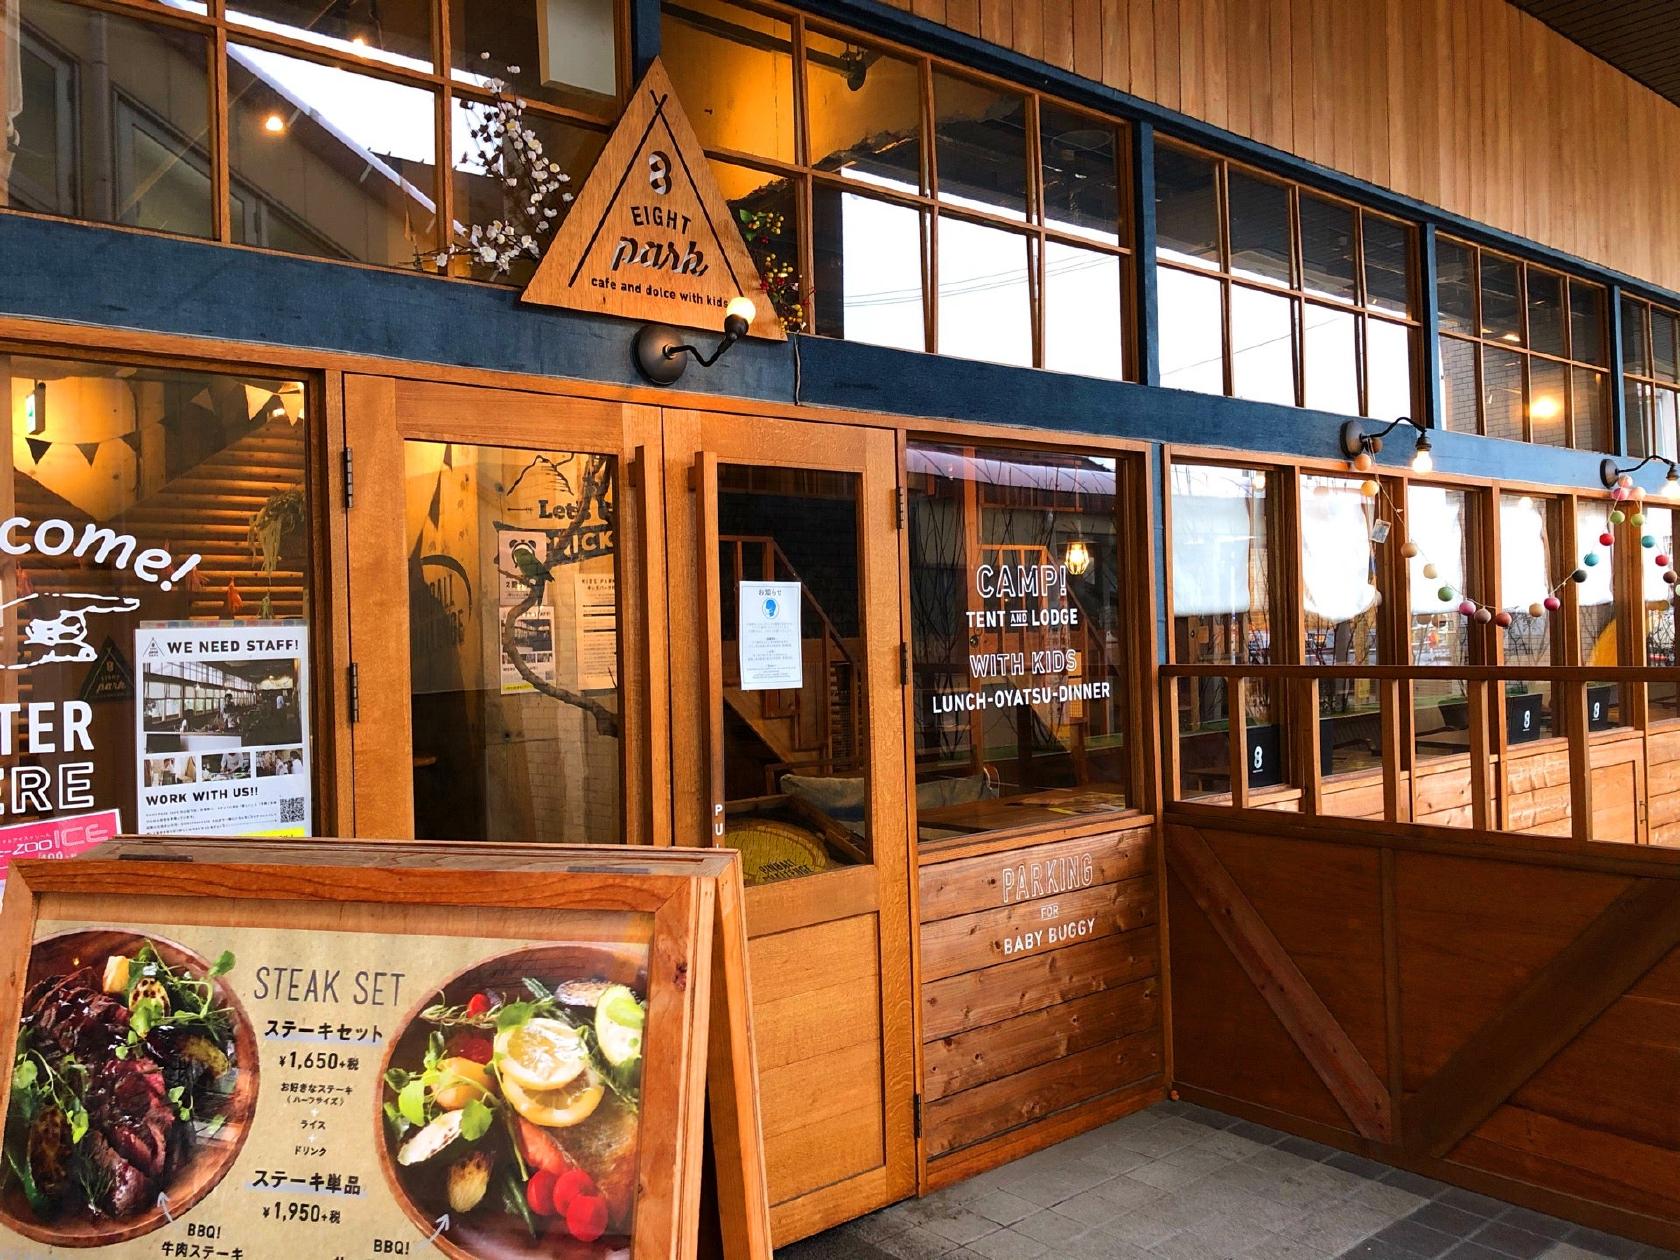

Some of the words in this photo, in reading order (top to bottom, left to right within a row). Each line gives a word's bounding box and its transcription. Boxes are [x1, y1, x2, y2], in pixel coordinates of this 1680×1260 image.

[630, 205, 692, 235] EIGHT
[611, 236, 709, 277] park
[591, 277, 617, 290] cafe
[621, 283, 641, 294] and
[646, 285, 676, 299] dolce
[680, 292, 703, 305] with
[706, 294, 729, 309] kids
[976, 564, 1067, 599] CAMP!
[966, 610, 1006, 628] TENT
[1010, 611, 1028, 625] AND
[1032, 608, 1078, 626] LODGE
[167, 641, 193, 654] WE
[200, 640, 240, 653] NEED
[247, 639, 299, 651] STAFF!
[969, 652, 1025, 678] WITH
[1031, 648, 1078, 675] KIDS
[1523, 709, 1531, 728] 8
[1593, 702, 1600, 718] 8
[1253, 745, 1263, 769] 8
[0, 762, 94, 815] RE
[146, 793, 187, 806] WORK
[193, 789, 228, 802] WITH
[233, 786, 259, 798] US!!
[1002, 852, 1093, 903] PARKING
[1041, 905, 1059, 919] FOR
[1004, 930, 1043, 955] BABY
[1048, 918, 1095, 944] BUGGY
[253, 966, 341, 1003] STEAK
[353, 971, 406, 1006] SET
[264, 1020, 383, 1043] ステーキセット
[280, 1082, 353, 1095] お好きなステーキ
[300, 1119, 326, 1130] ライス
[295, 1145, 327, 1157] ドリンク
[252, 1170, 361, 1195] ステーキ単品
[187, 1223, 221, 1239] BBQ!
[161, 1241, 243, 1260] 牛肉ステーキ
[373, 1239, 410, 1255] BBQ!
